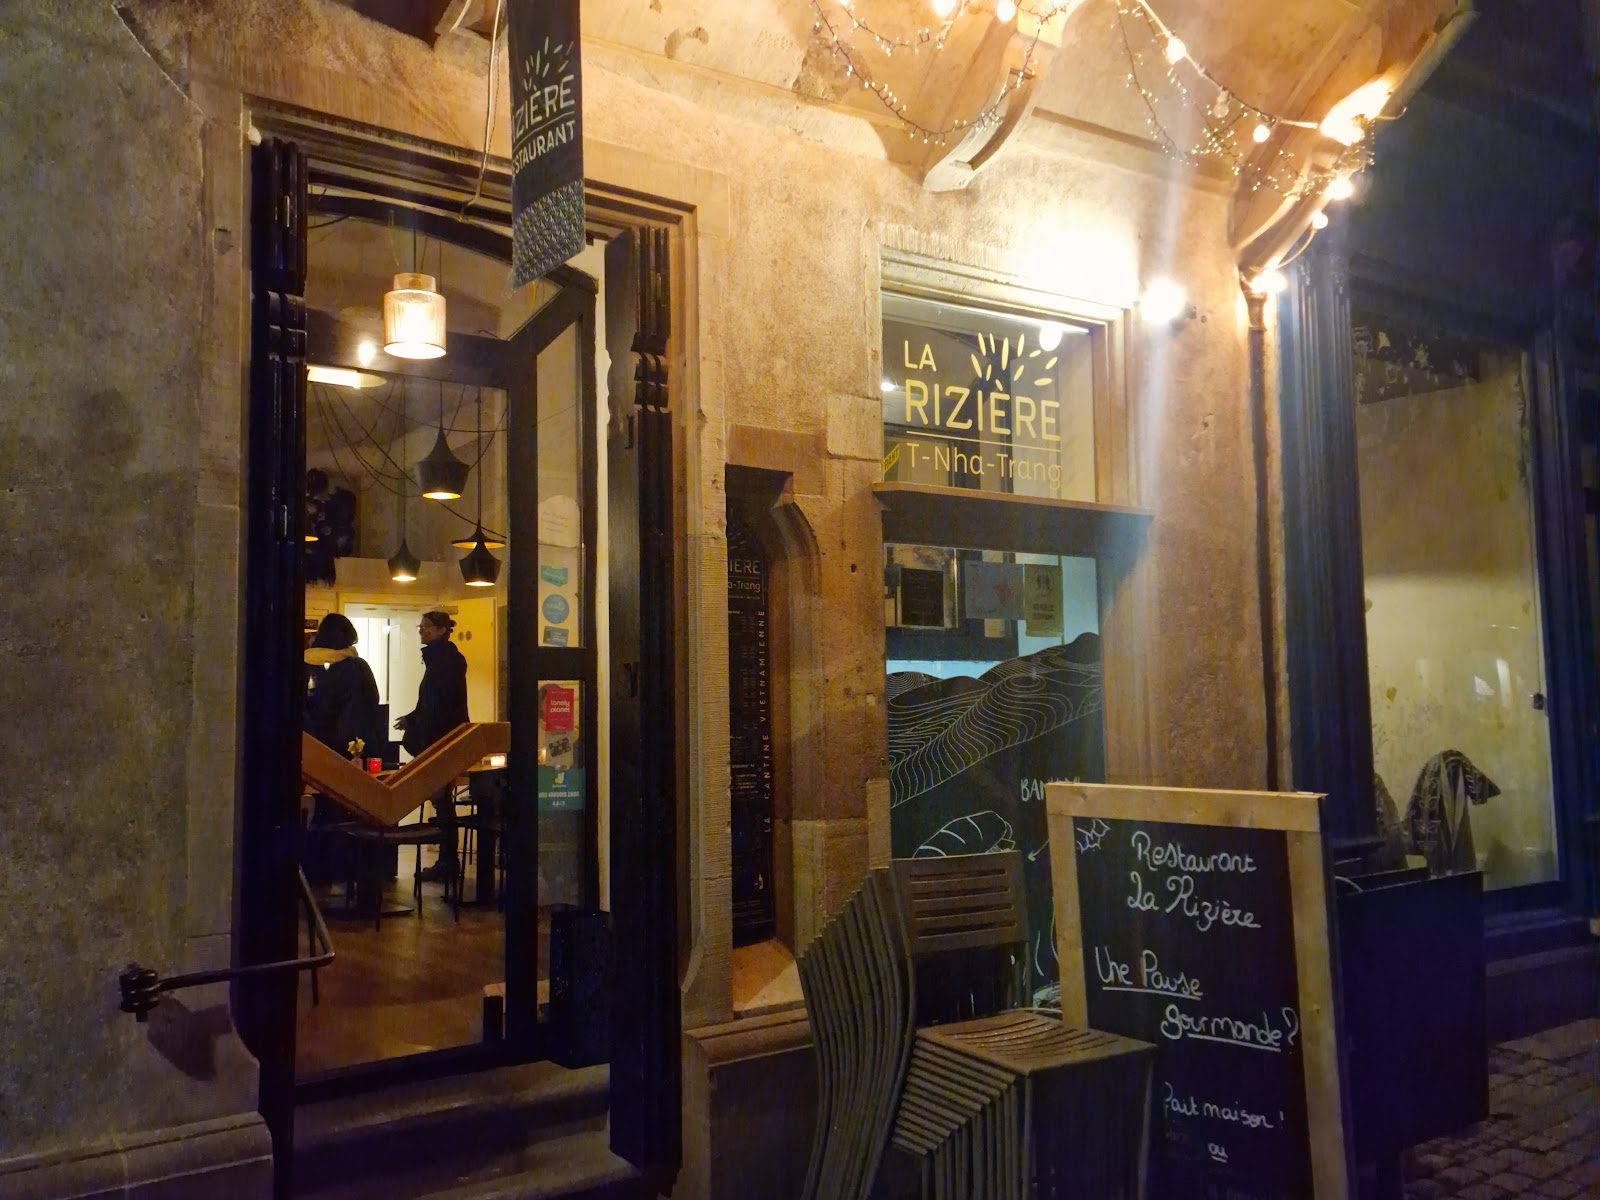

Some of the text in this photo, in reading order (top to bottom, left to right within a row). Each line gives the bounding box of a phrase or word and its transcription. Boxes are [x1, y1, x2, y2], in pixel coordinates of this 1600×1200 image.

[512, 120, 576, 176] STAURANT
[904, 339, 937, 372] LA
[905, 378, 1062, 442] RIZIÈRE
[758, 610, 771, 833] LA CANTINE VIETNAMIENNE
[1131, 830, 1257, 873] Restaurant
[1127, 871, 1262, 932] La Rizière
[1095, 946, 1204, 997] Une Pause
